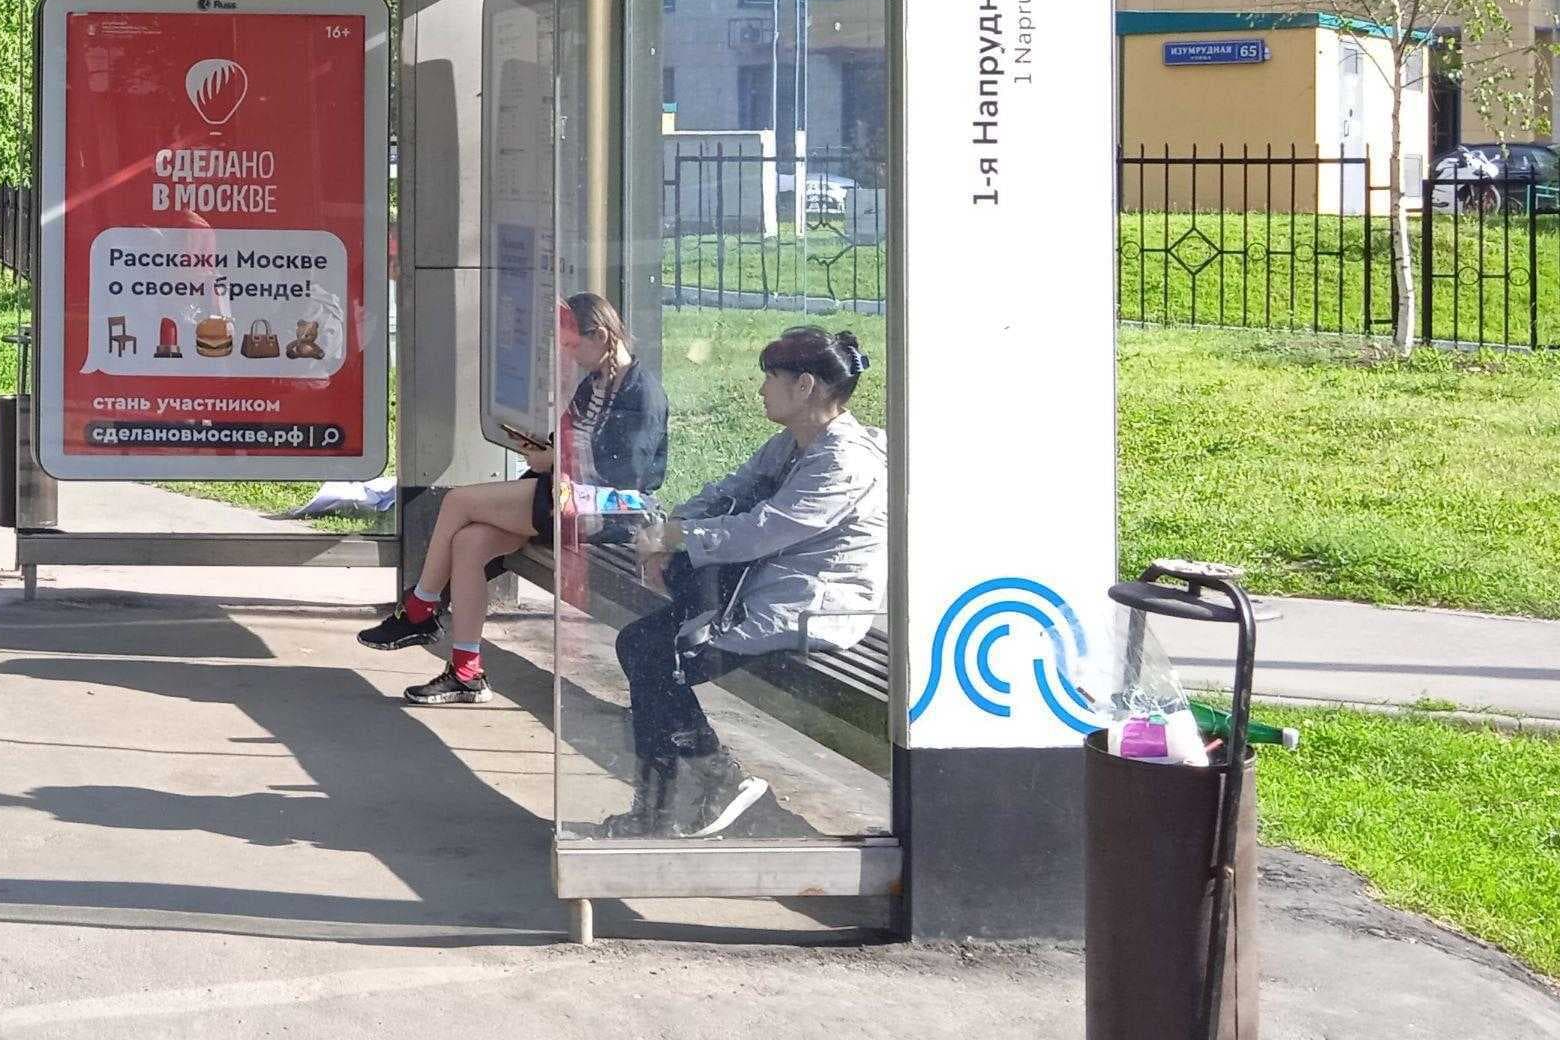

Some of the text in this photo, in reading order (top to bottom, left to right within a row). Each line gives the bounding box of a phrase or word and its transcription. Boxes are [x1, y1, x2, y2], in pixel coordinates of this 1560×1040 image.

[325, 25, 351, 38] 16+
[1170, 44, 1258, 58] ИЗУМРУДНАЯ 65
[1013, 72, 1032, 85] 1
[155, 149, 275, 182] СДЕЛАНО
[973, 158, 1000, 206] 1-я
[109, 248, 328, 270] Расскажи Москве
[108, 276, 312, 302] о своем бренде!
[92, 396, 281, 414] стань участником
[91, 426, 305, 447] сделановмоскве.рф
